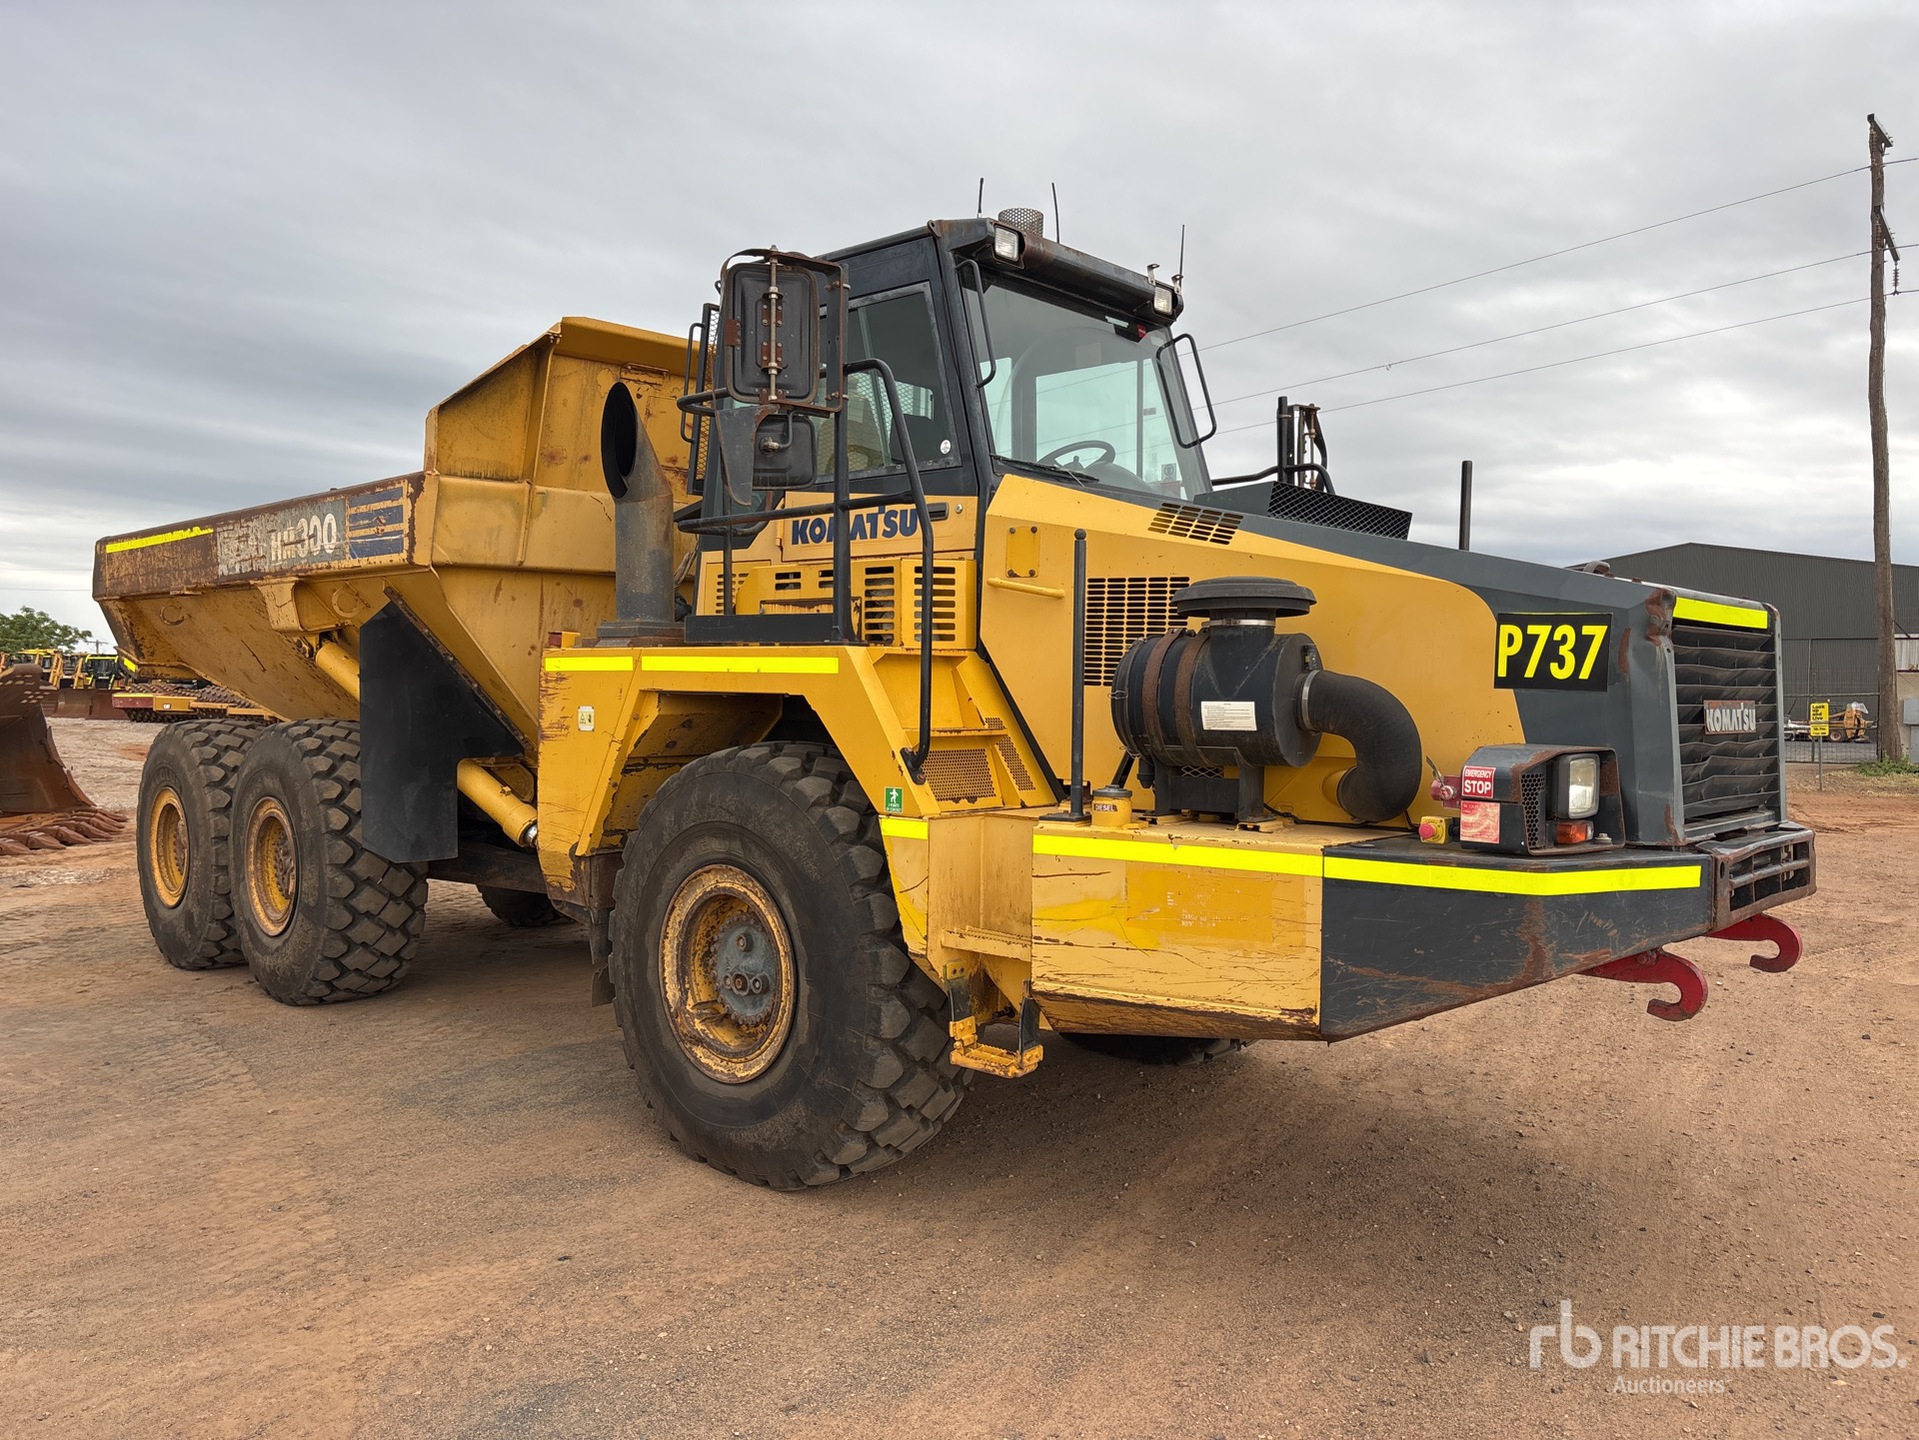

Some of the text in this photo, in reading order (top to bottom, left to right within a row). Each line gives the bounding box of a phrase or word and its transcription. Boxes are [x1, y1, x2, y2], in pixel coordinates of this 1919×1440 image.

[1497, 623, 1608, 680] P737
[1706, 702, 1756, 731] KOMATSU
[1465, 769, 1492, 778] EMERGENCY
[1465, 779, 1491, 794] STOP
